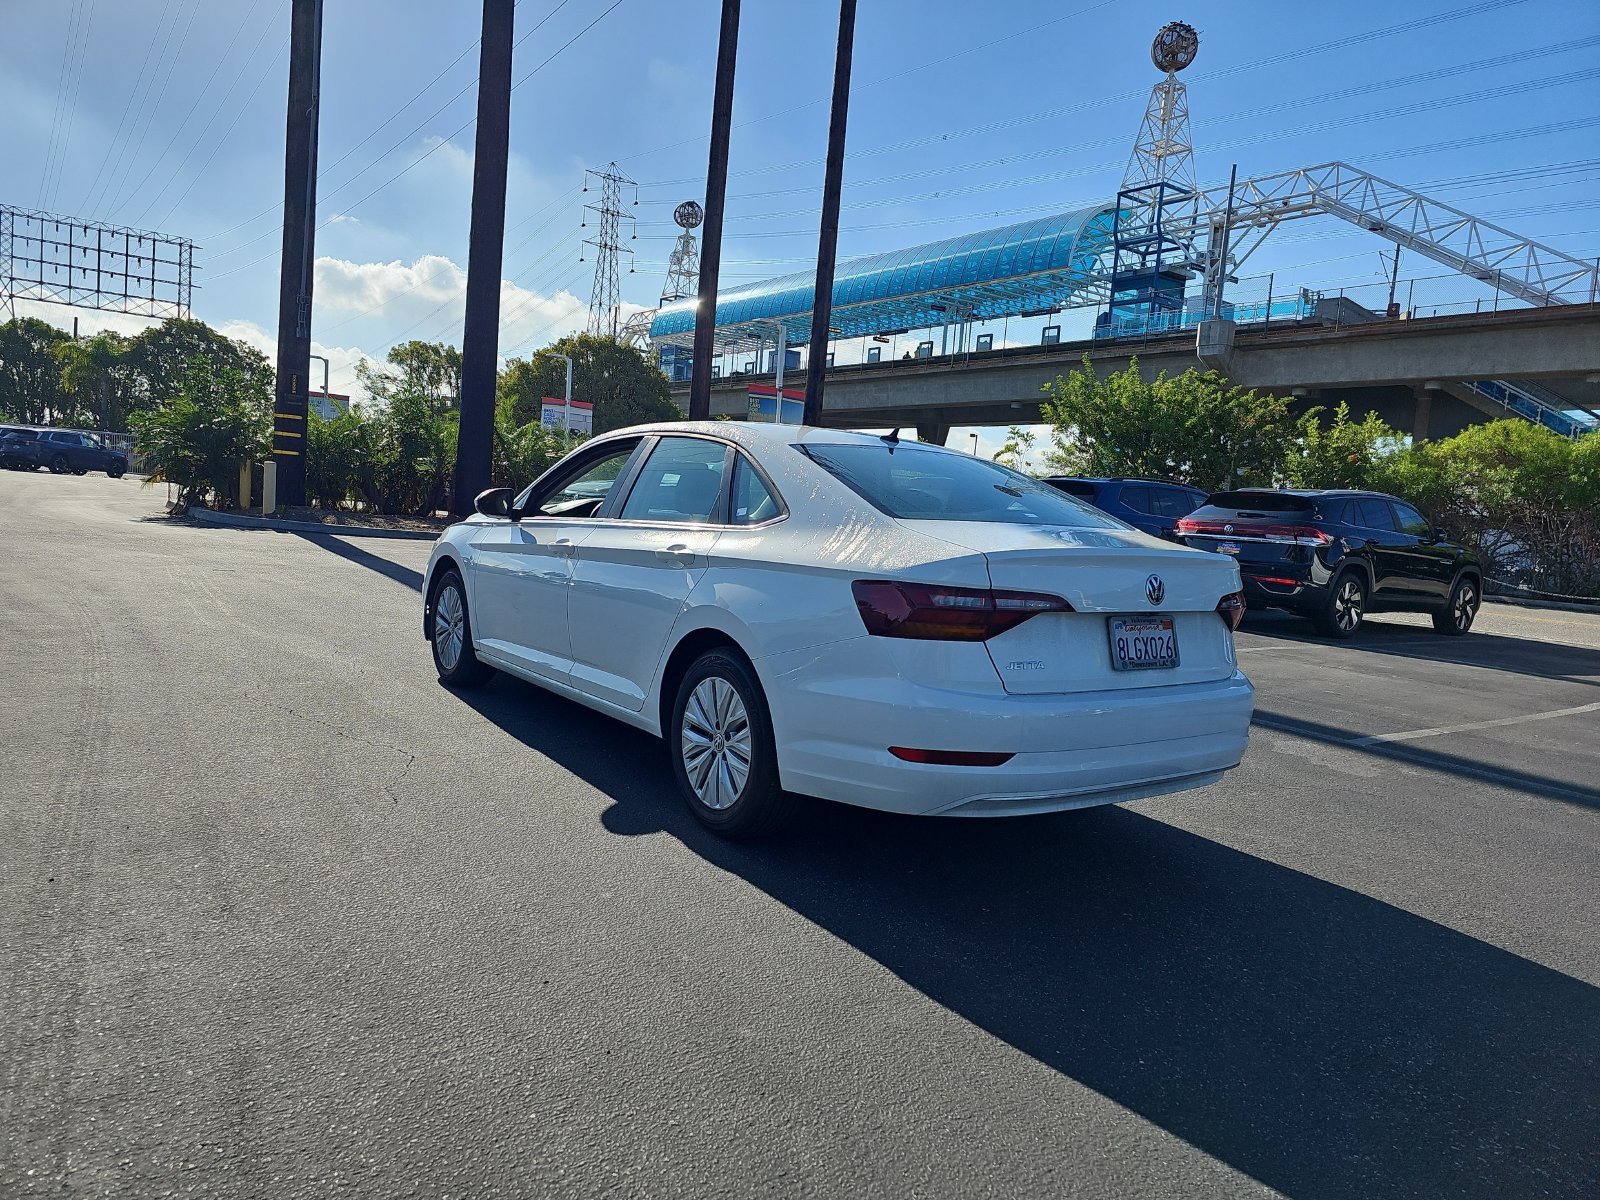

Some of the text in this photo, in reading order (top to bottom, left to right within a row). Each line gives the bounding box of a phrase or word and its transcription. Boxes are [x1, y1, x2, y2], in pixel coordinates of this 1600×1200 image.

[1125, 624, 1163, 635] California
[1117, 636, 1173, 660] 8LGX026
[1006, 661, 1045, 670] JETTA
